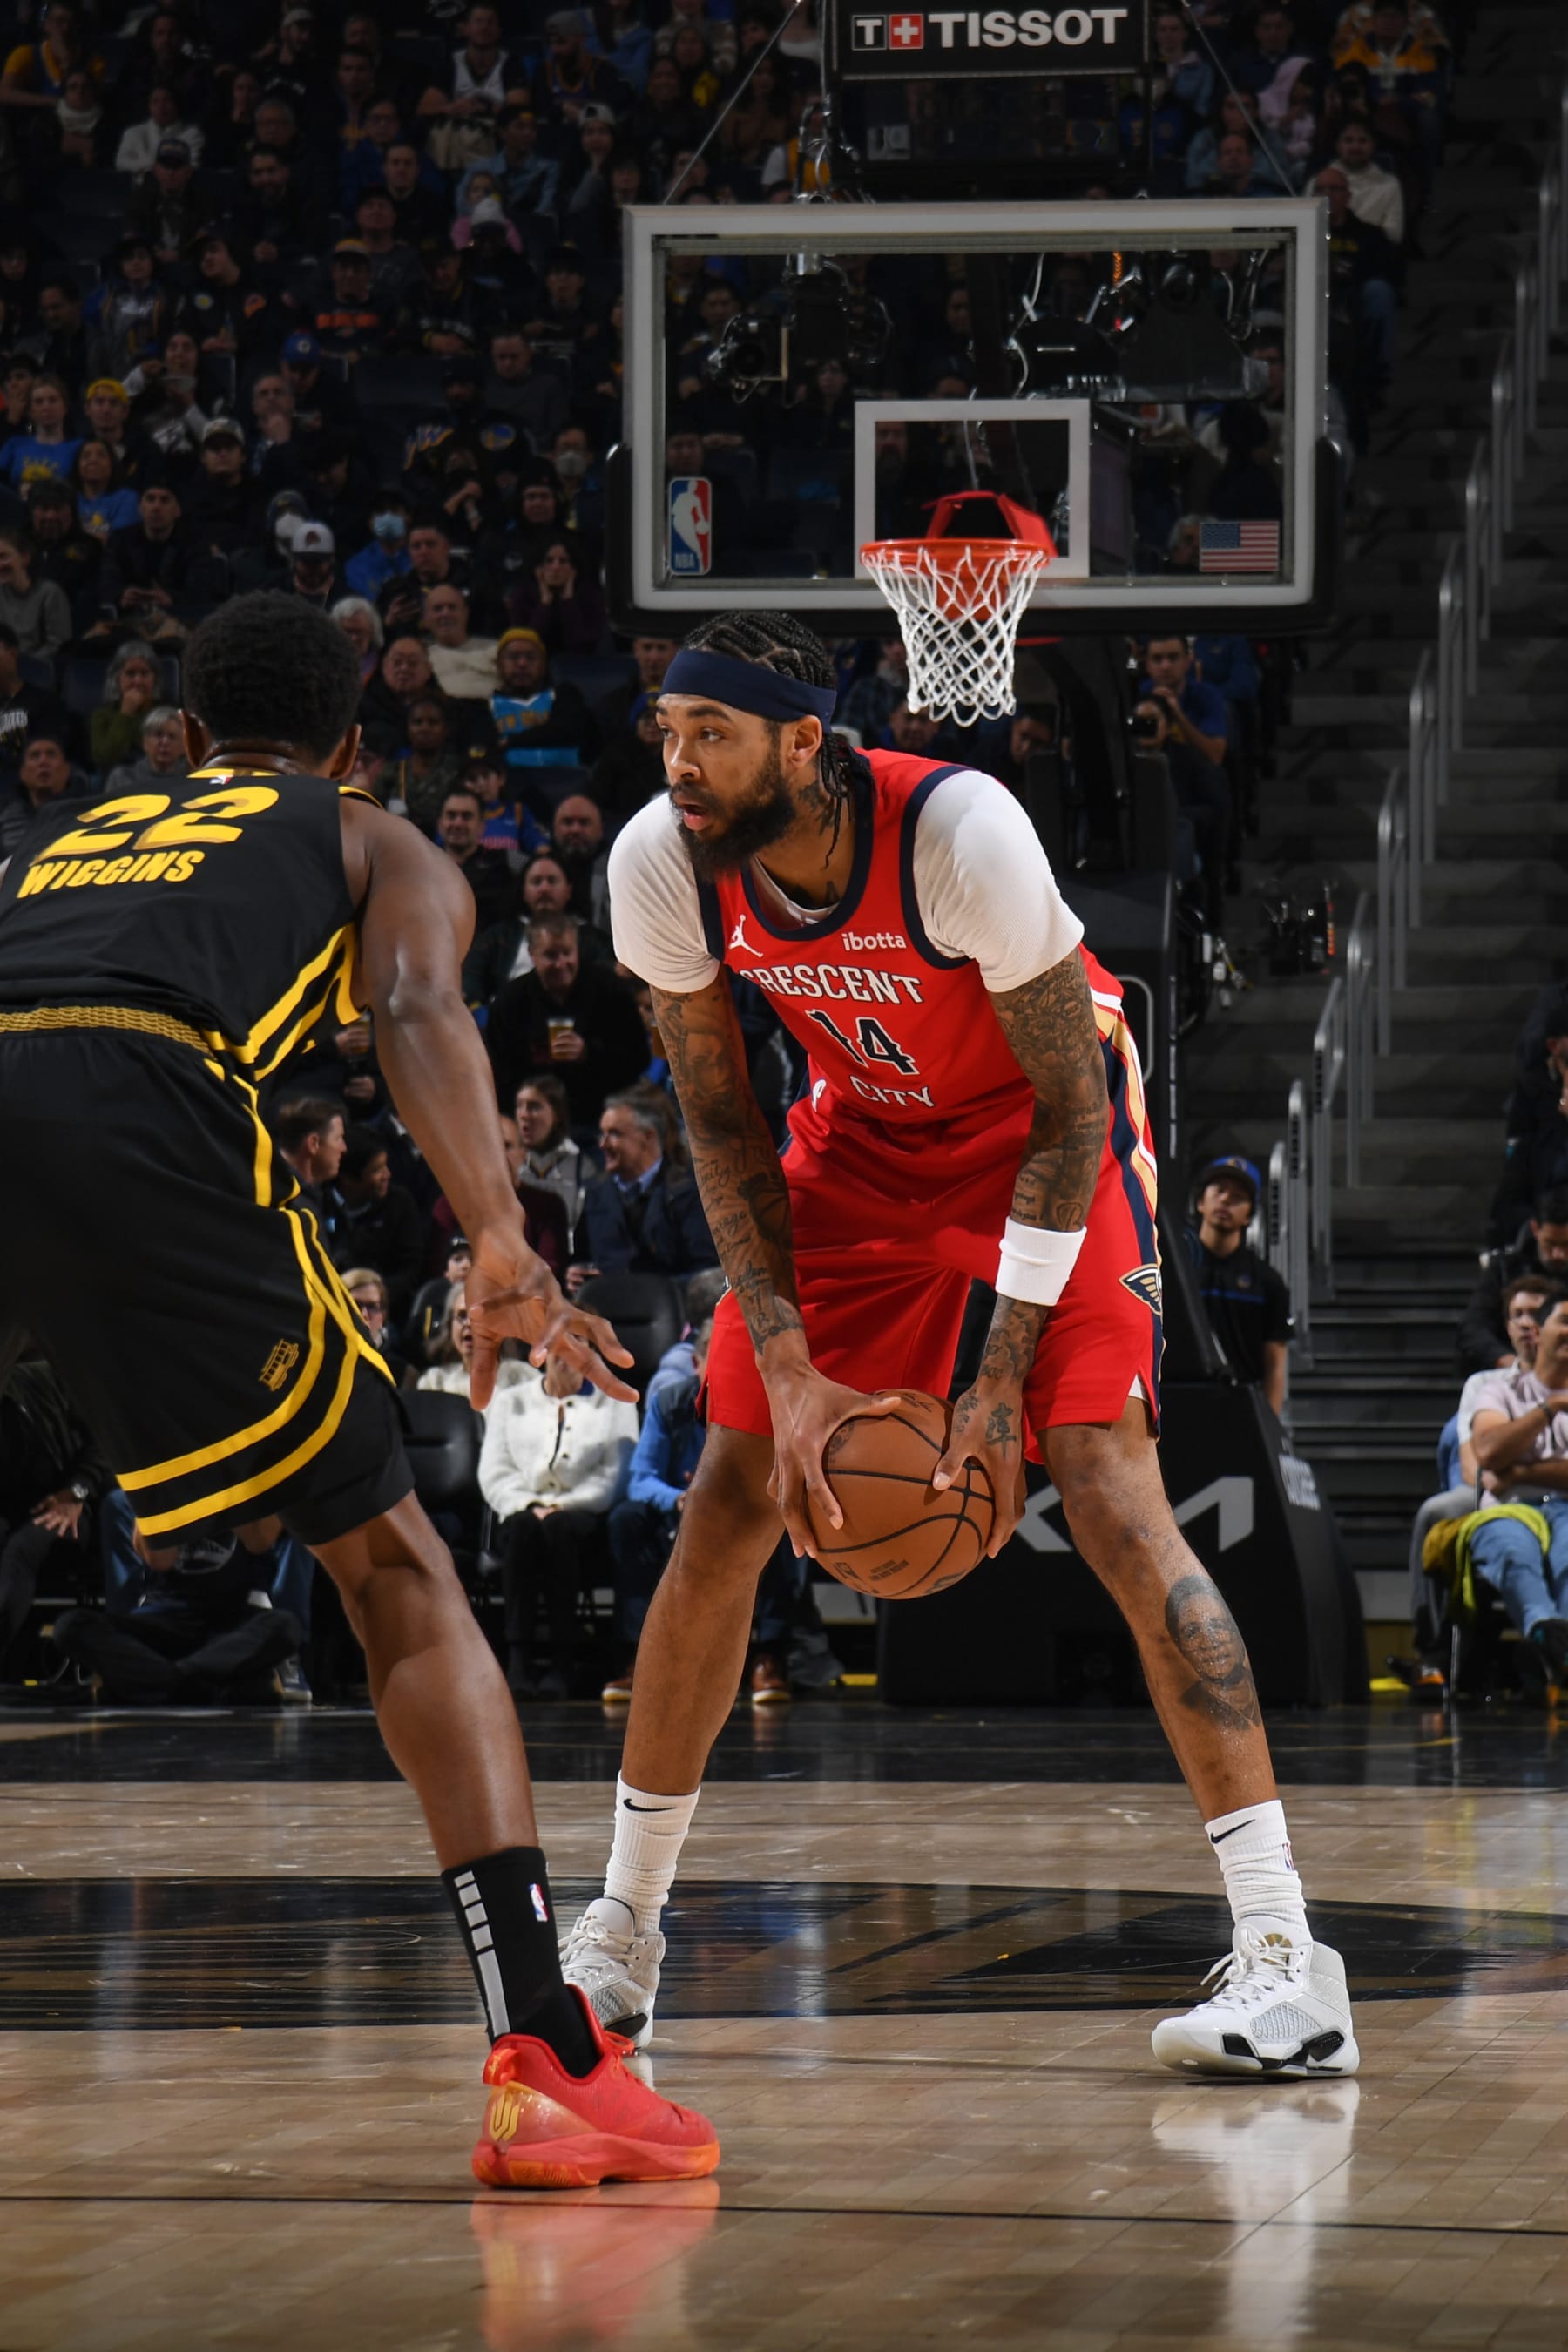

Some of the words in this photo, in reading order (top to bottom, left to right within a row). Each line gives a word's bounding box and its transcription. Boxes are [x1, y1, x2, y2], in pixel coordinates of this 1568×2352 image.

[929, 9, 1128, 48] TISSOT
[675, 553, 695, 569] NBA
[29, 786, 280, 868] 22
[17, 850, 206, 899] WIGGINS
[841, 931, 907, 951] ibotta
[804, 1009, 921, 1076] 14
[849, 1075, 935, 1108] CITY
